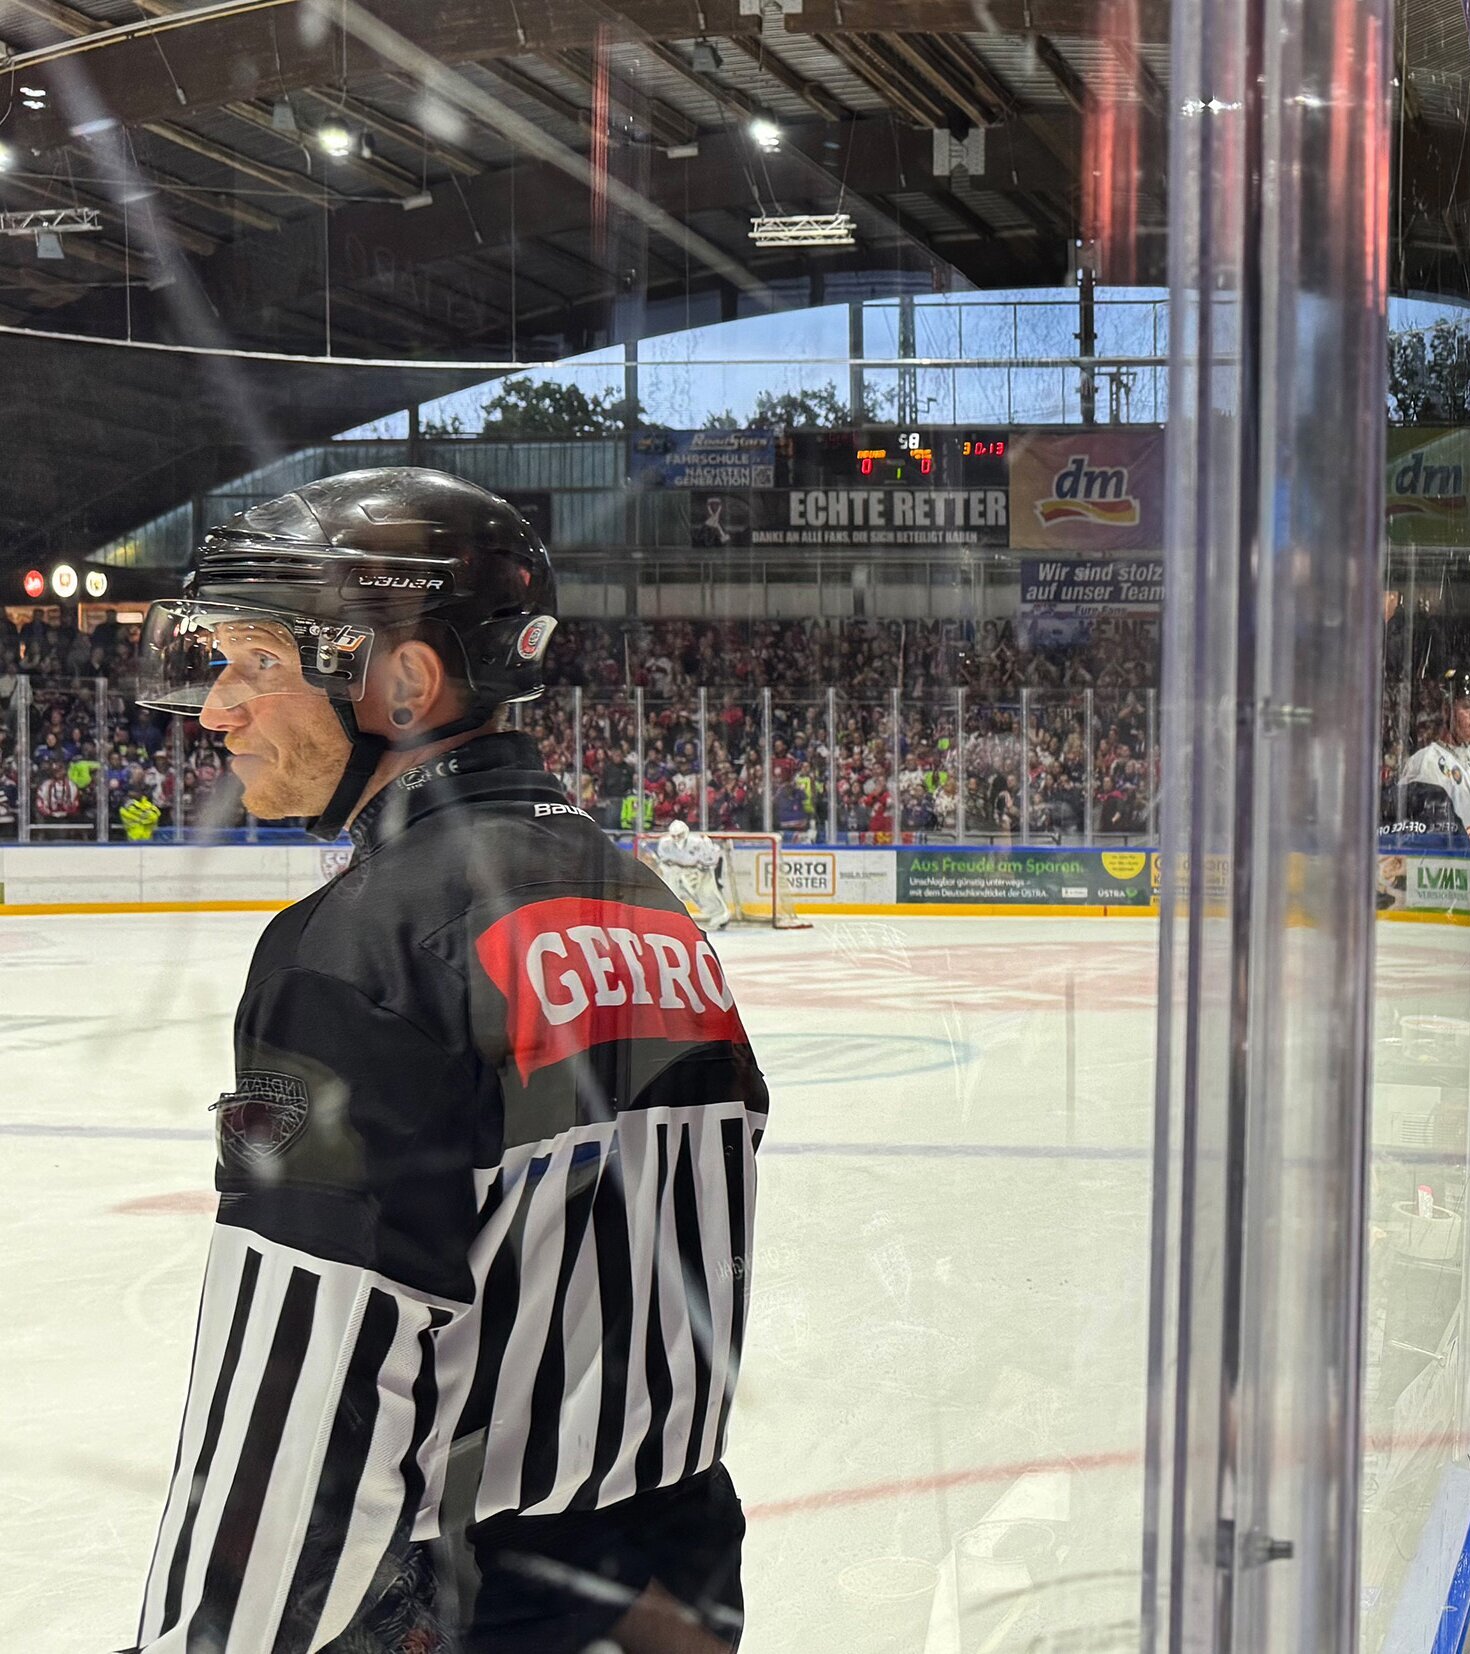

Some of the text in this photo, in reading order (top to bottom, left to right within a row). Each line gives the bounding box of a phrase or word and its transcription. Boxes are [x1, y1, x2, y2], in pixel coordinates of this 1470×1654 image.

[666, 453, 750, 465] FAHRSCHULE
[674, 476, 750, 487] GENERATION
[1055, 457, 1125, 499] dm
[1396, 452, 1462, 495] dm
[790, 491, 1007, 526] ECHTE RETTER
[752, 531, 784, 543] DANKE
[786, 531, 800, 543] AN
[802, 531, 822, 543] ALLE
[853, 531, 868, 543] DIE
[946, 531, 978, 543] HABEN
[1038, 562, 1163, 581] Wir sind stolz
[1026, 582, 1166, 600] auf unser Team
[910, 858, 1084, 876] Aus Freude am Sparen.
[909, 877, 955, 889] Unschlagbar
[957, 877, 985, 889] günstig
[986, 879, 1025, 889] unterwegs
[909, 888, 922, 898] mit
[925, 888, 939, 898] dem
[1008, 888, 1020, 898] der
